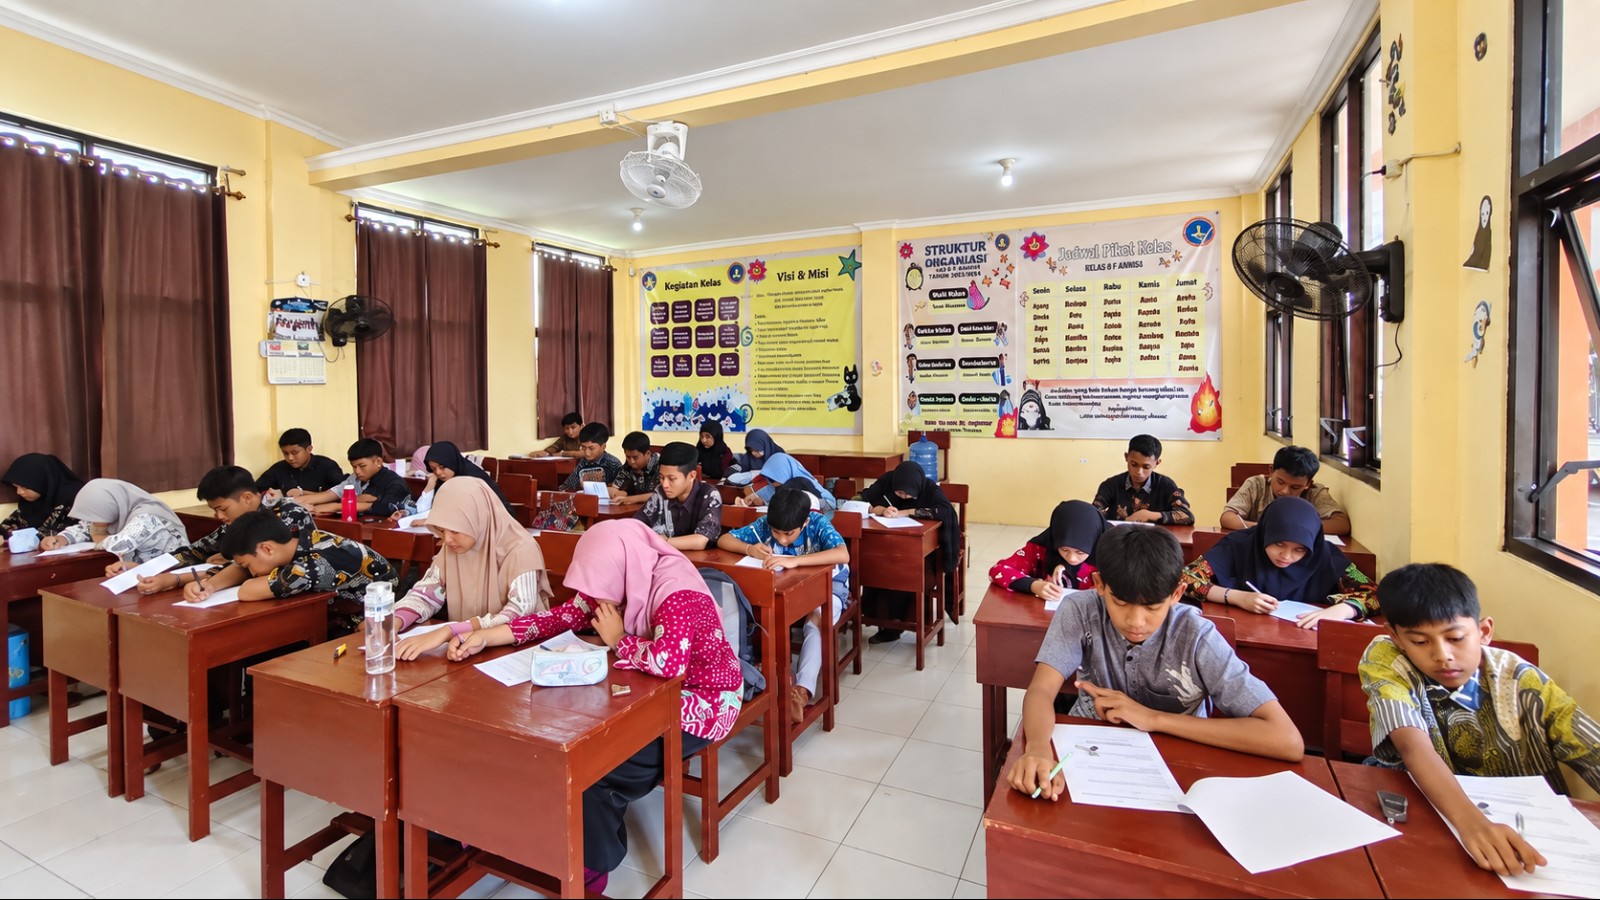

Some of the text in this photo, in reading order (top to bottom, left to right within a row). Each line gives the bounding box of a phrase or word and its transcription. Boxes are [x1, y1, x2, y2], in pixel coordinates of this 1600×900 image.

[925, 241, 986, 256] STRUKTUR
[1058, 243, 1100, 261] Jadwal
[1137, 238, 1172, 255] Kelas
[777, 268, 829, 282] Visi & Misi
[664, 279, 722, 292] Kegiatan Kelas
[1103, 283, 1122, 291] Rabu
[1138, 280, 1160, 288] Kamis
[1176, 279, 1198, 287] Jumat
